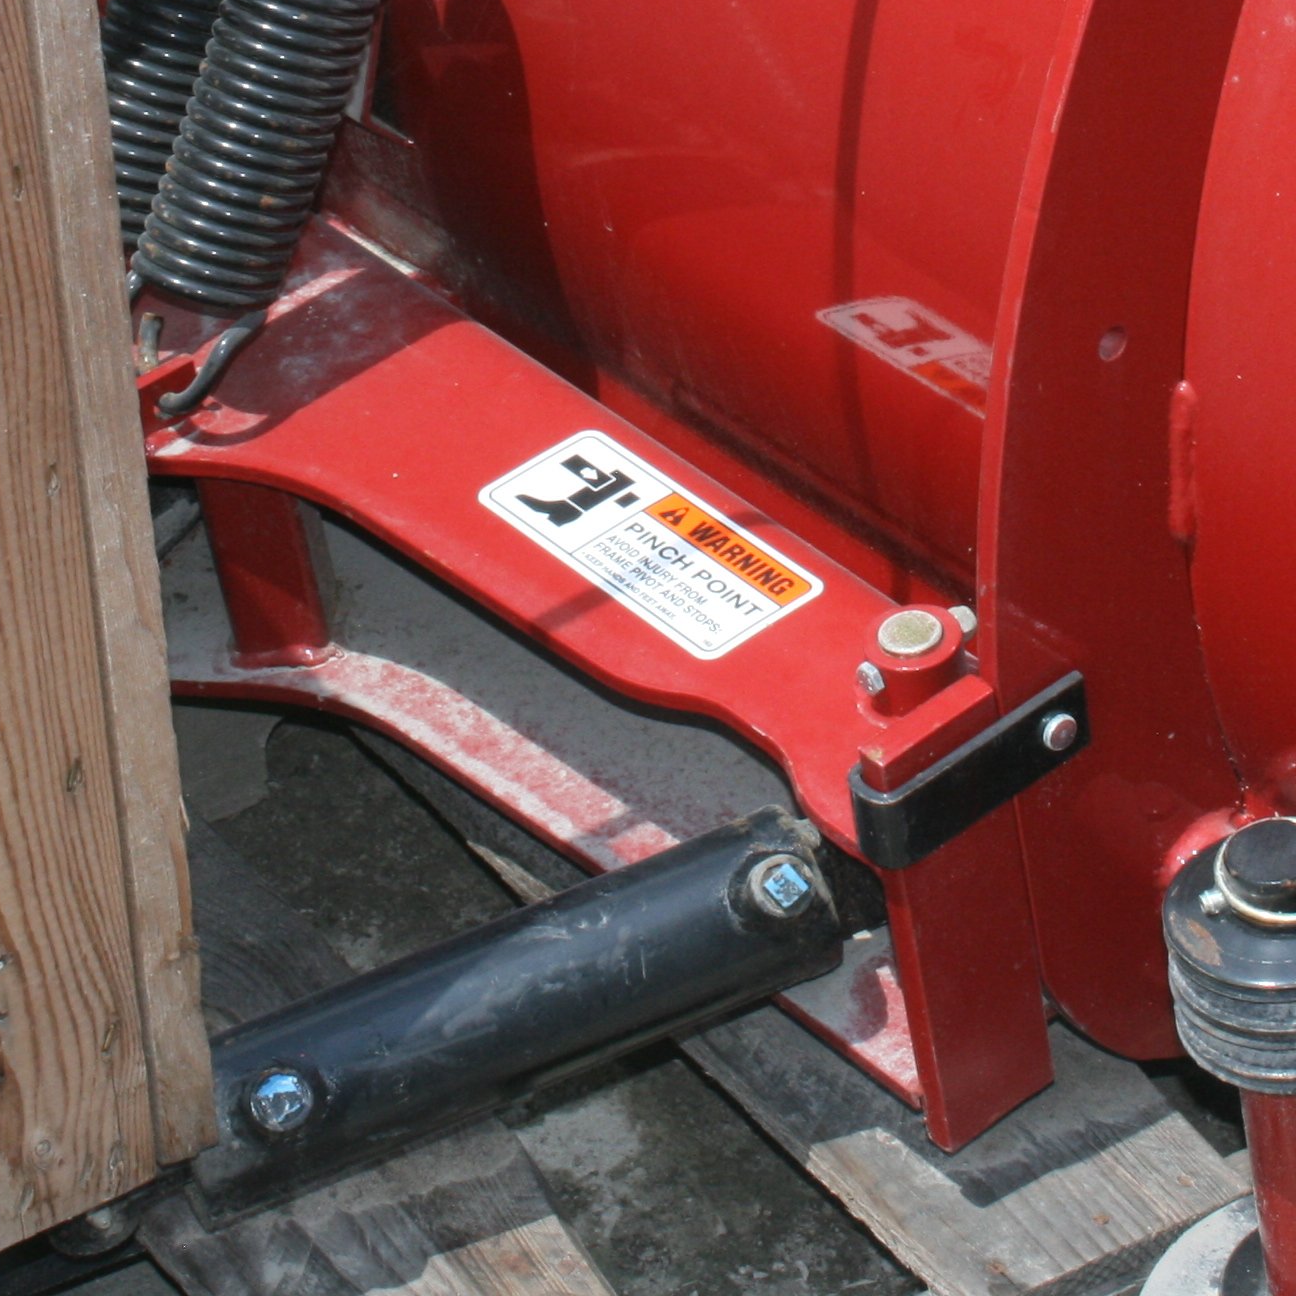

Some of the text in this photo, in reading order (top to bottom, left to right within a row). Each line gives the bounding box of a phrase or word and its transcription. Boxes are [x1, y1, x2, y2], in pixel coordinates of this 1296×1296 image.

[593, 541, 634, 570] FRAME
[629, 566, 664, 591] PIVOT
[659, 588, 686, 608] AND
[606, 534, 709, 606] AVOID INJURY FROM
[623, 521, 764, 617] PINCH POINT
[688, 520, 795, 598] WARNING
